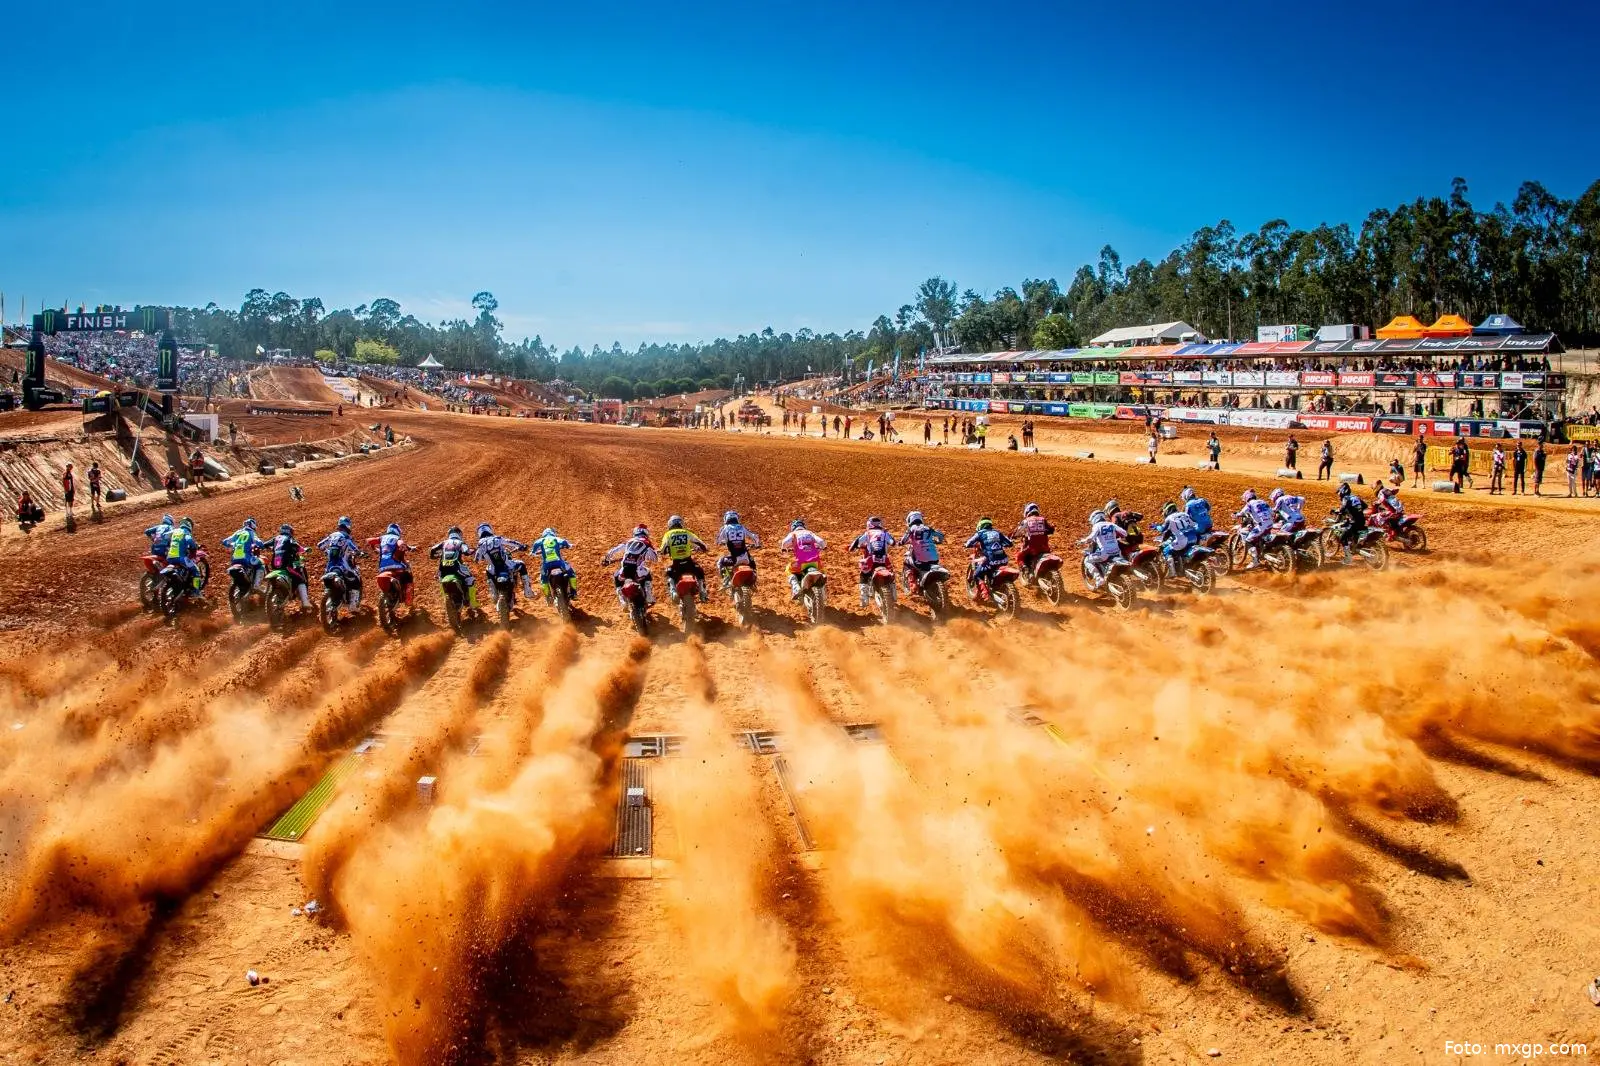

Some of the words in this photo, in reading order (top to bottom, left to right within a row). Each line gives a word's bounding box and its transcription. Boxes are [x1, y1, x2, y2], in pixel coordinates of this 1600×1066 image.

[67, 316, 126, 328] FINISH
[1304, 375, 1332, 383] DUCATI
[1341, 375, 1370, 384] DUCATI
[1336, 421, 1368, 430] DUCATI
[1101, 525, 1113, 535] 64
[671, 534, 688, 546] 253
